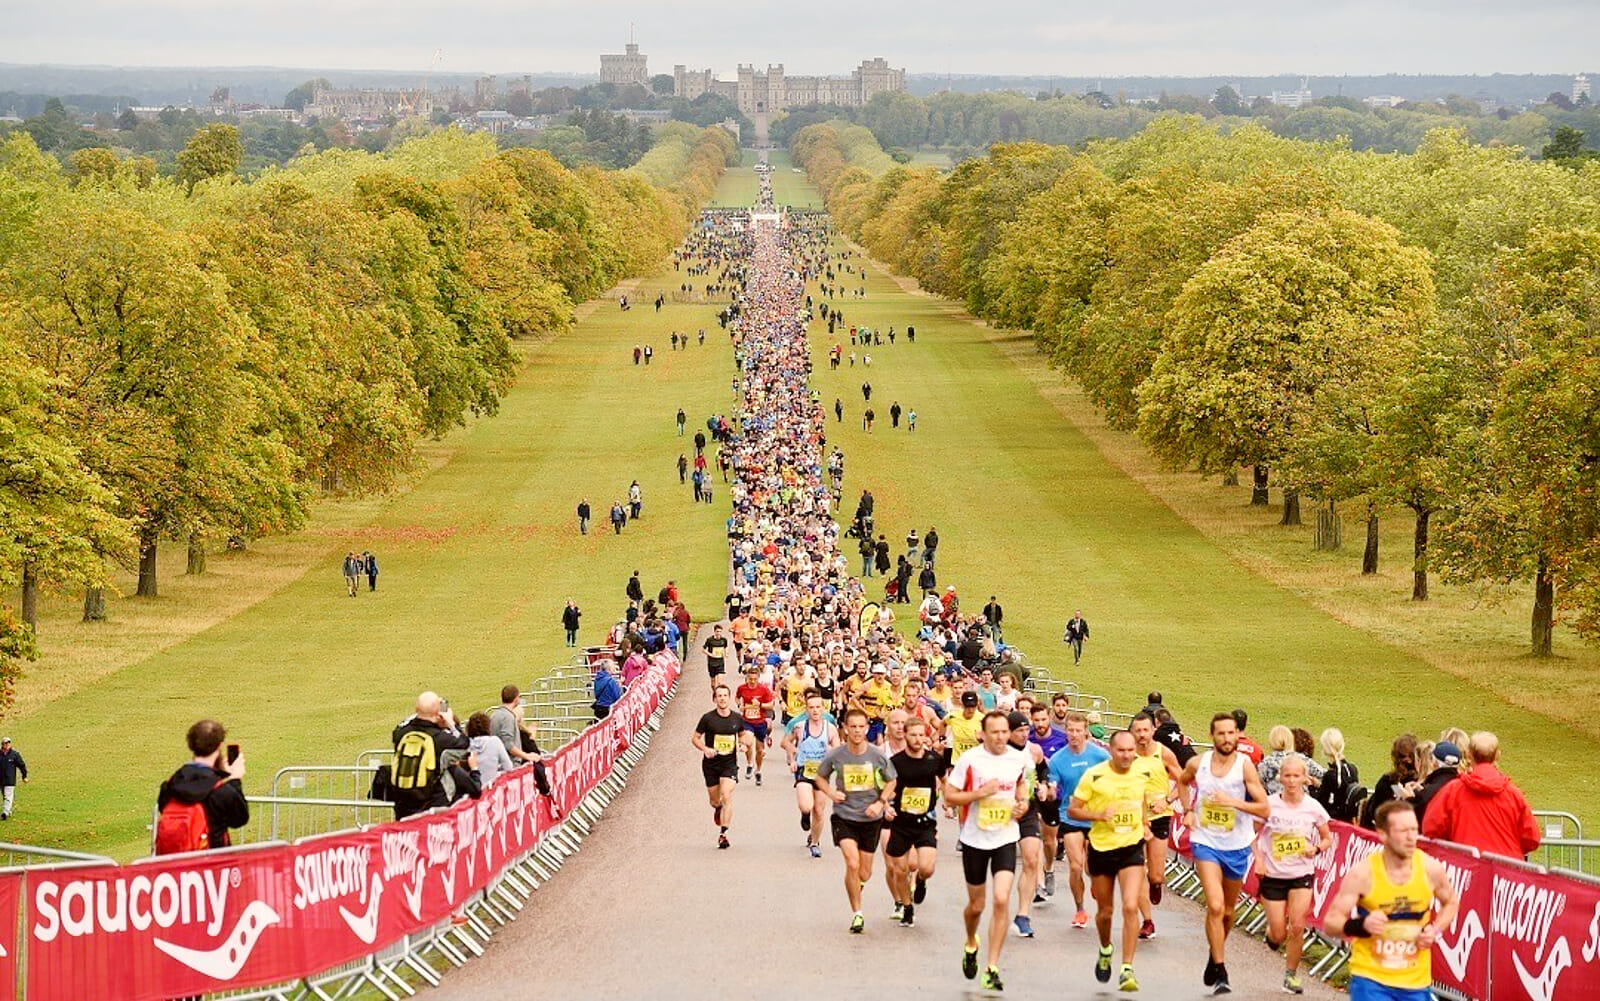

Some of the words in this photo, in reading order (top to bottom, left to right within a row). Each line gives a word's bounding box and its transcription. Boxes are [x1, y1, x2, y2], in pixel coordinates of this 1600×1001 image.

[849, 774, 868, 785] 287
[906, 796, 925, 807] 260
[989, 810, 1006, 820] 112
[1114, 813, 1134, 824] 381
[1206, 811, 1229, 823] 383
[1278, 841, 1301, 853] 343
[294, 845, 368, 910] saucony
[33, 868, 230, 942] saucony
[1375, 939, 1418, 955] 1096
